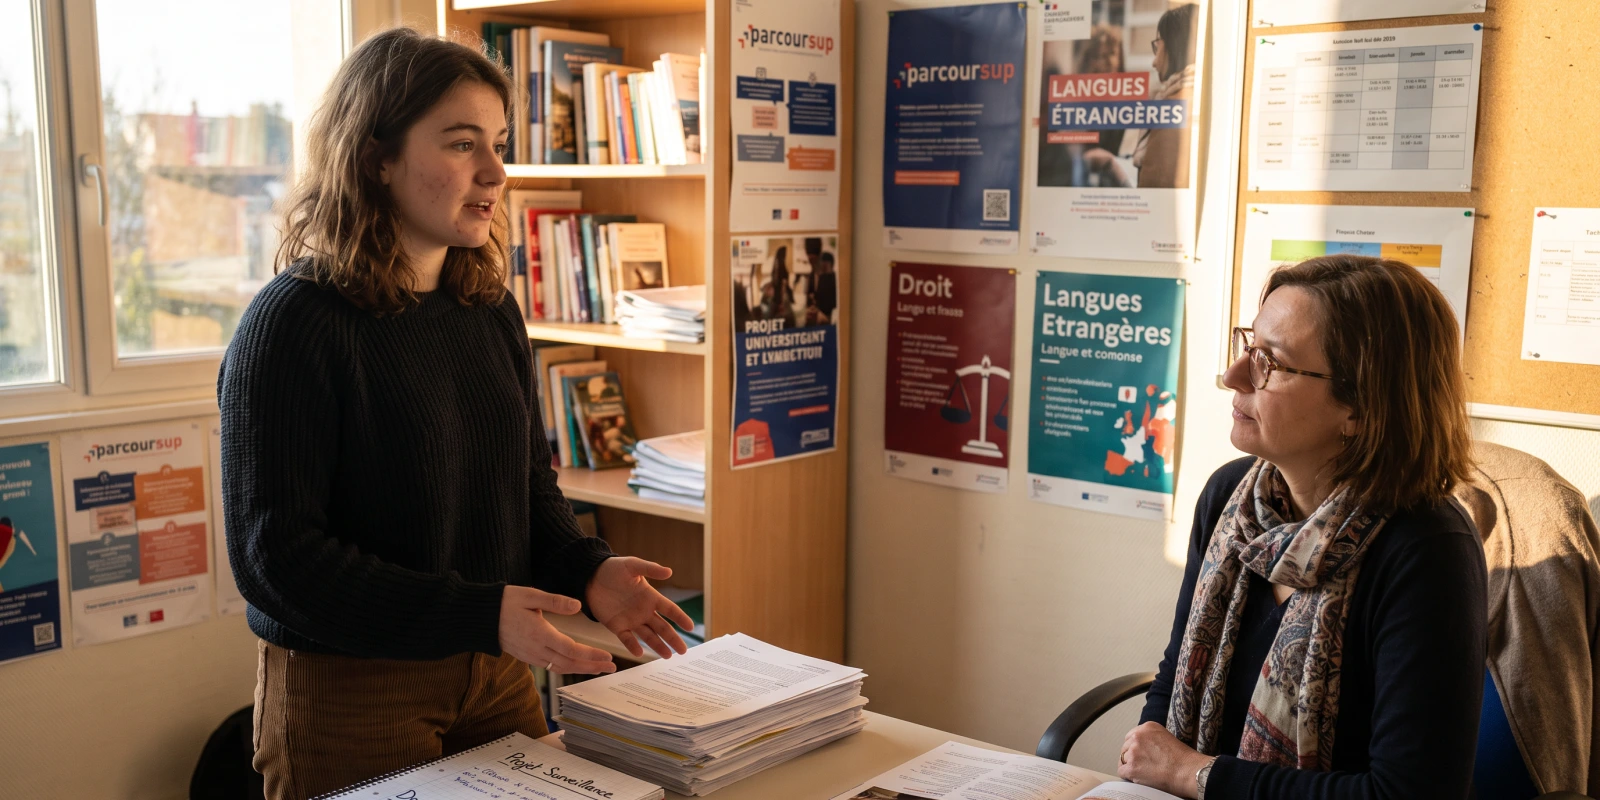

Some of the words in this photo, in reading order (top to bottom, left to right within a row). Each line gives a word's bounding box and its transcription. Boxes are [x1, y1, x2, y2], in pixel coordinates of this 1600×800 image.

[750, 27, 834, 56] parcoursup
[907, 63, 1015, 88] parcoursup
[1052, 77, 1145, 98] LANGUES
[1051, 102, 1183, 126] ÉTRANGÈRES
[899, 273, 953, 298] Droit
[926, 305, 937, 315] et
[1043, 283, 1142, 316] Langues
[745, 318, 785, 335] PROJET
[1042, 312, 1172, 348] Etrangères
[745, 352, 760, 367] ET
[1041, 342, 1079, 359] Langue
[1080, 347, 1093, 359] et
[97, 435, 182, 460] parcoursup
[504, 752, 544, 771] Projet
[543, 766, 616, 800] Surveillance
